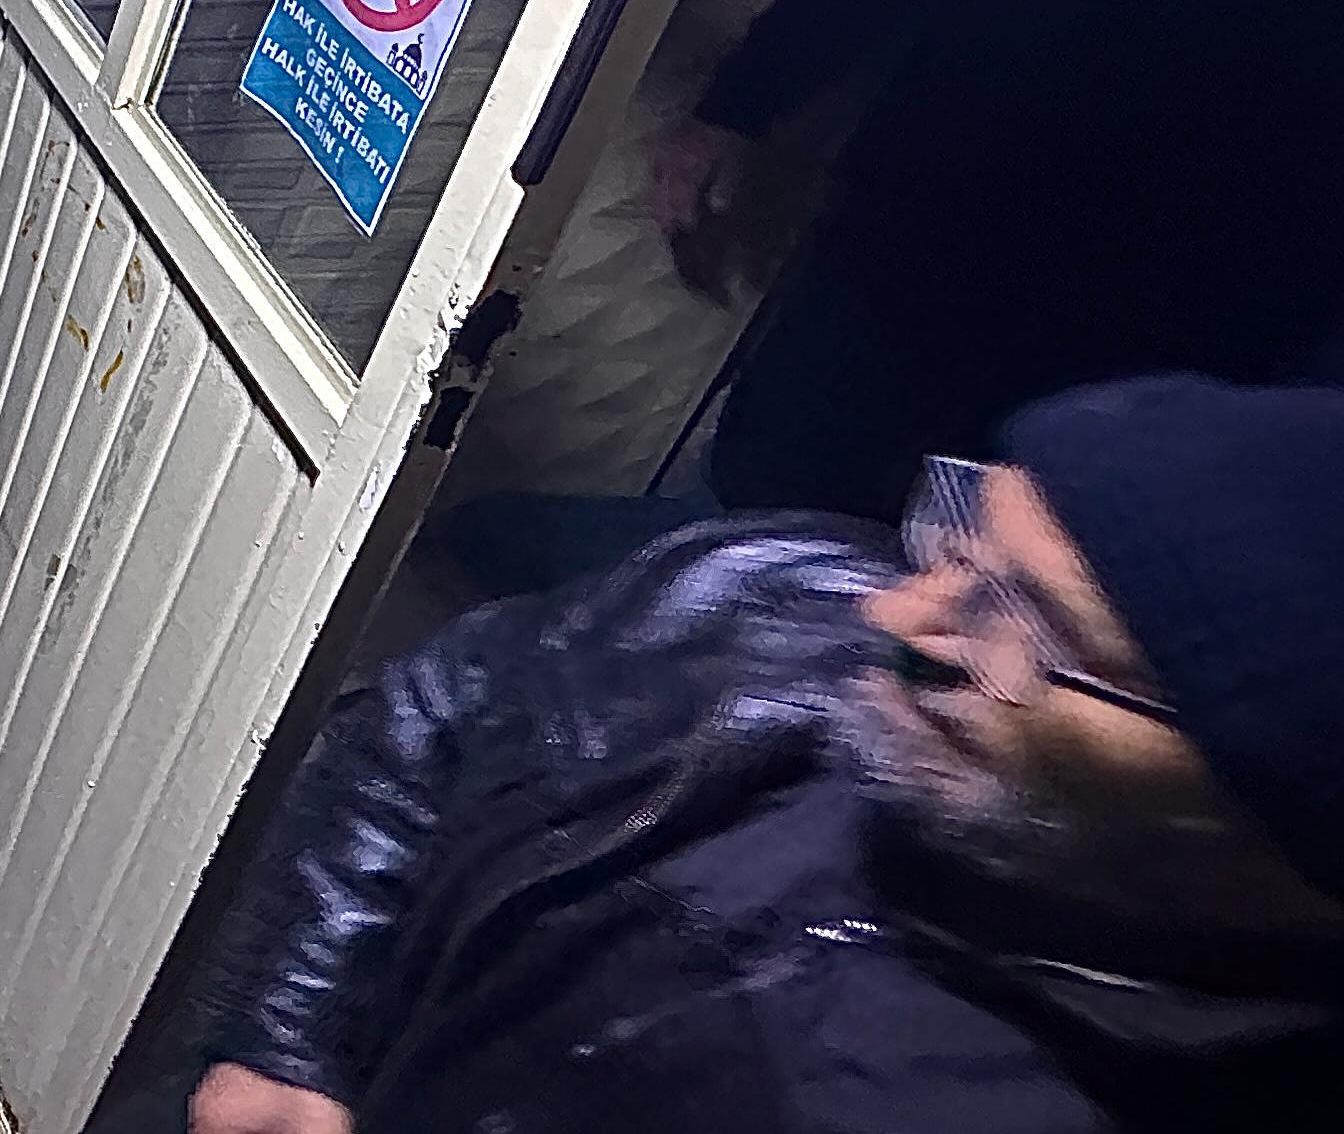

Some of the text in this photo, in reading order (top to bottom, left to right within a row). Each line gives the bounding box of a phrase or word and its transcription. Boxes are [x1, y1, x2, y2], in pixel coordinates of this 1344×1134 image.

[261, 37, 391, 184] HALK İLE İRTİBATI
[306, 48, 369, 123] GEÇİNCE
[315, 22, 340, 61] İLE
[340, 48, 410, 134] İRTİBATA
[295, 97, 345, 164] KESİN !
